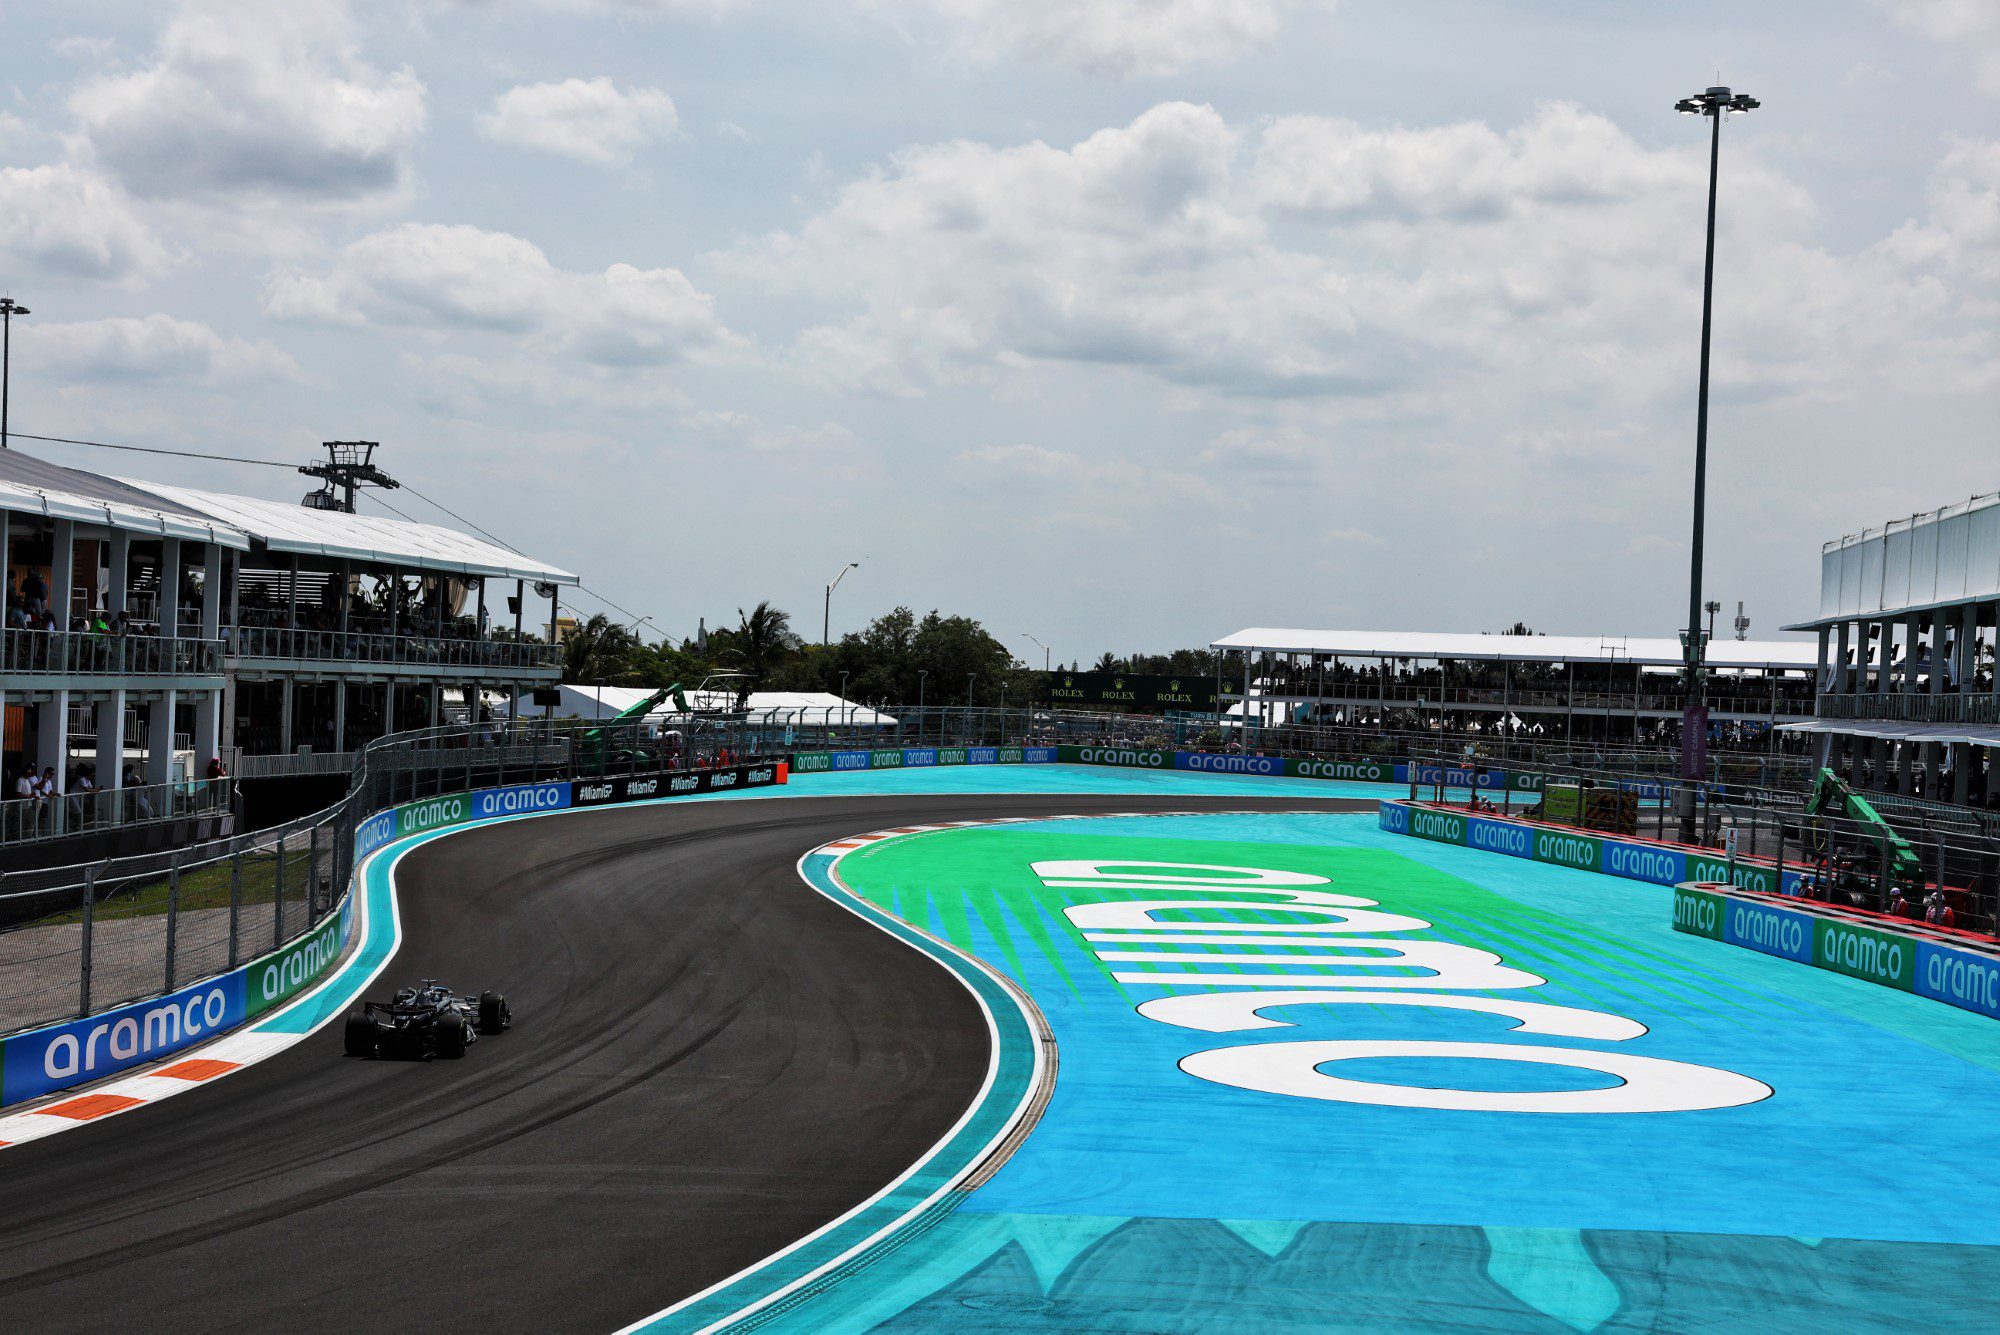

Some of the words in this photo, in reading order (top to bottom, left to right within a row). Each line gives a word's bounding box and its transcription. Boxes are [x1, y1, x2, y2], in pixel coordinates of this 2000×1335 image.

[1051, 688, 1084, 698] ROLEX
[1102, 690, 1135, 700] ROLEX
[1157, 693, 1192, 703] ROLEX
[797, 755, 829, 770] aramco
[836, 754, 866, 768] aramco
[873, 753, 900, 766] aramco
[907, 751, 934, 764] aramco
[940, 750, 965, 763] aramco
[970, 750, 994, 762] aramco
[1000, 750, 1022, 762] aramco
[1027, 750, 1049, 761] aramco
[1080, 748, 1162, 767] aramco
[1189, 755, 1272, 773] aramco
[1297, 761, 1381, 780] aramco
[483, 786, 559, 813] aramco
[404, 799, 462, 831] aramco
[1414, 812, 1460, 839] aramco
[1474, 823, 1525, 853] aramco
[1539, 834, 1593, 866] aramco
[1611, 847, 1675, 881] aramco
[1674, 893, 1715, 932] amco
[1734, 907, 1802, 954] aramco
[262, 926, 335, 1000] aramco
[1824, 928, 1901, 980] aramco
[1927, 953, 2000, 1009] aramc
[44, 988, 226, 1079] aramco
